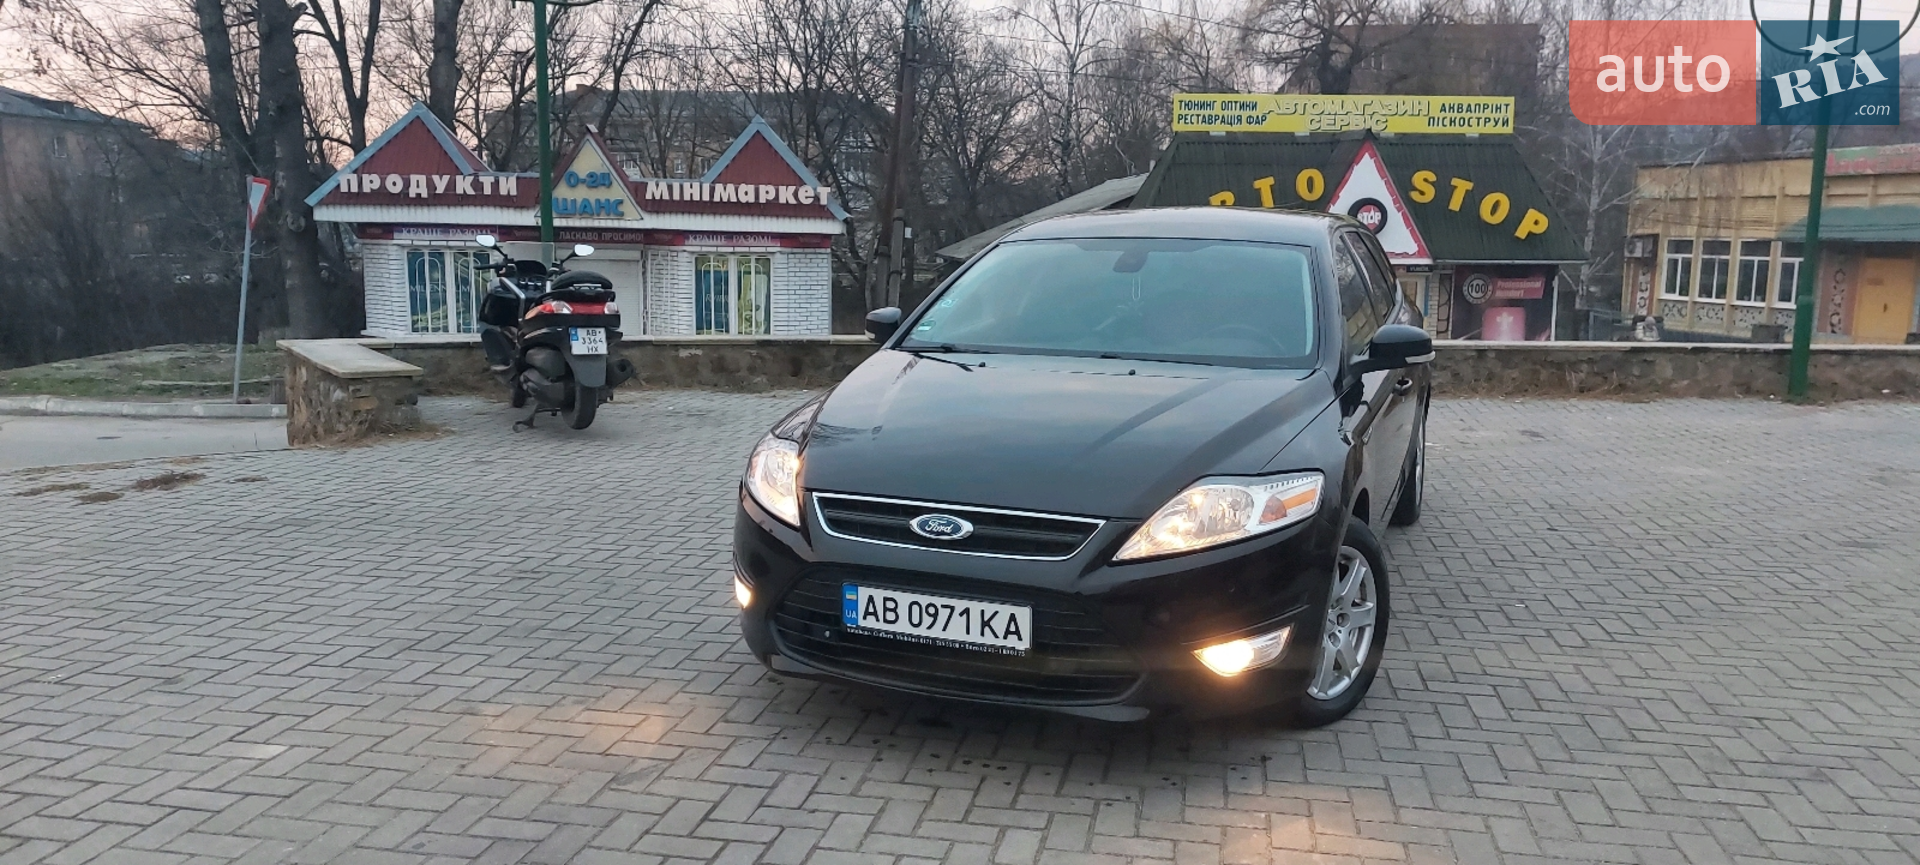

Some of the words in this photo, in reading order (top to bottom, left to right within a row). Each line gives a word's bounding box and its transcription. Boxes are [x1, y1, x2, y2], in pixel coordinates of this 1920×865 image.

[1178, 100, 1217, 111] ТЮНИНГ
[1264, 98, 1430, 117] АВТОМАГАЗИН
[1439, 103, 1511, 114] АКВАПРІНТ
[1177, 113, 1242, 127] РЕСТАВРАЦІЯ
[1246, 114, 1267, 126] ФАР
[1306, 114, 1388, 132] СЕРВІС
[1427, 115, 1510, 128] ПІСКОСТРУЙ
[339, 173, 518, 199] ПРОДУКТИ
[564, 170, 612, 189] 0-24
[552, 198, 625, 216] ШАНС
[1408, 169, 1549, 240] STOP
[559, 231, 598, 240] ЛАСКАВО
[602, 232, 644, 241] ПРОСИМО!
[1469, 283, 1487, 295] 100
[925, 519, 954, 533] Ford
[845, 609, 858, 619] UA
[862, 594, 900, 625] AB
[907, 600, 971, 636] 0971
[980, 608, 1023, 642] KA
